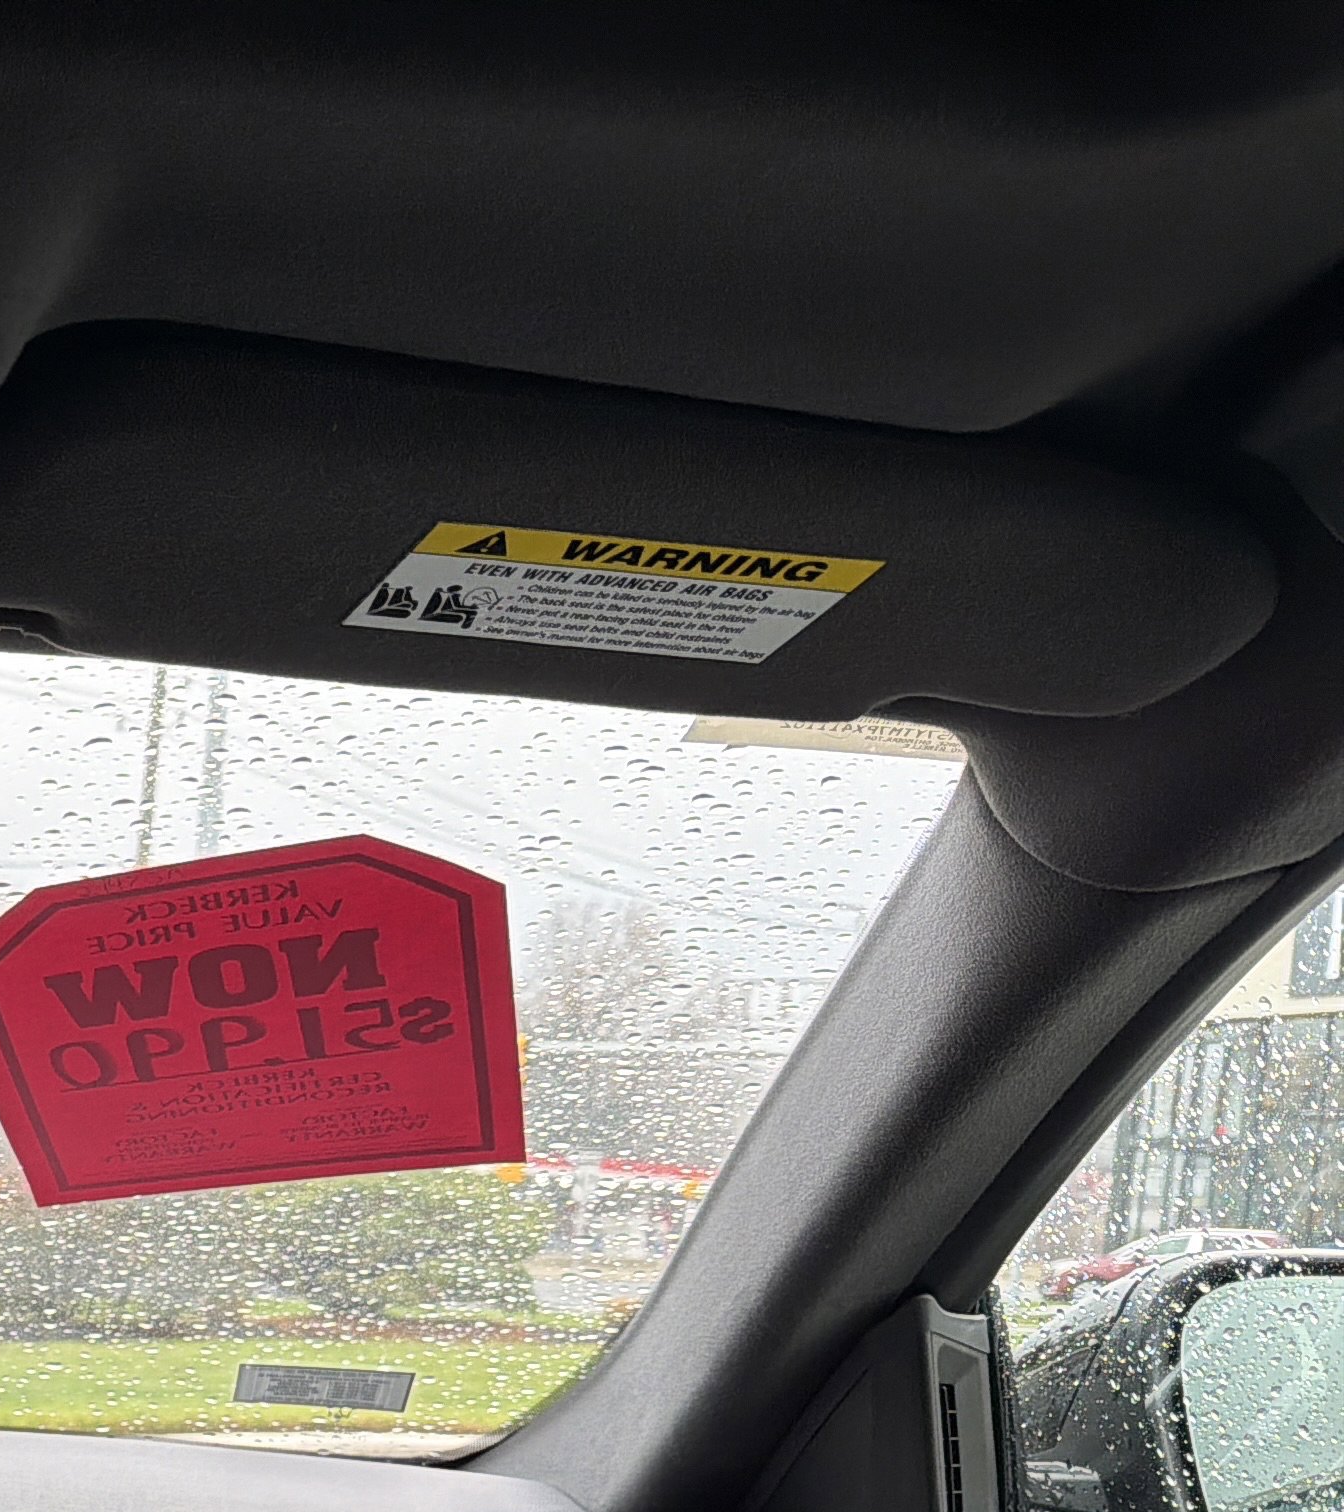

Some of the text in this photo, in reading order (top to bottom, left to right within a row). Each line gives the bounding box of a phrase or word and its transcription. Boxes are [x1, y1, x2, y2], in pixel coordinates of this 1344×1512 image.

[463, 562, 774, 602] EVEN WITH ADVANCED AIR BAGS
[561, 539, 830, 583] WARNING
